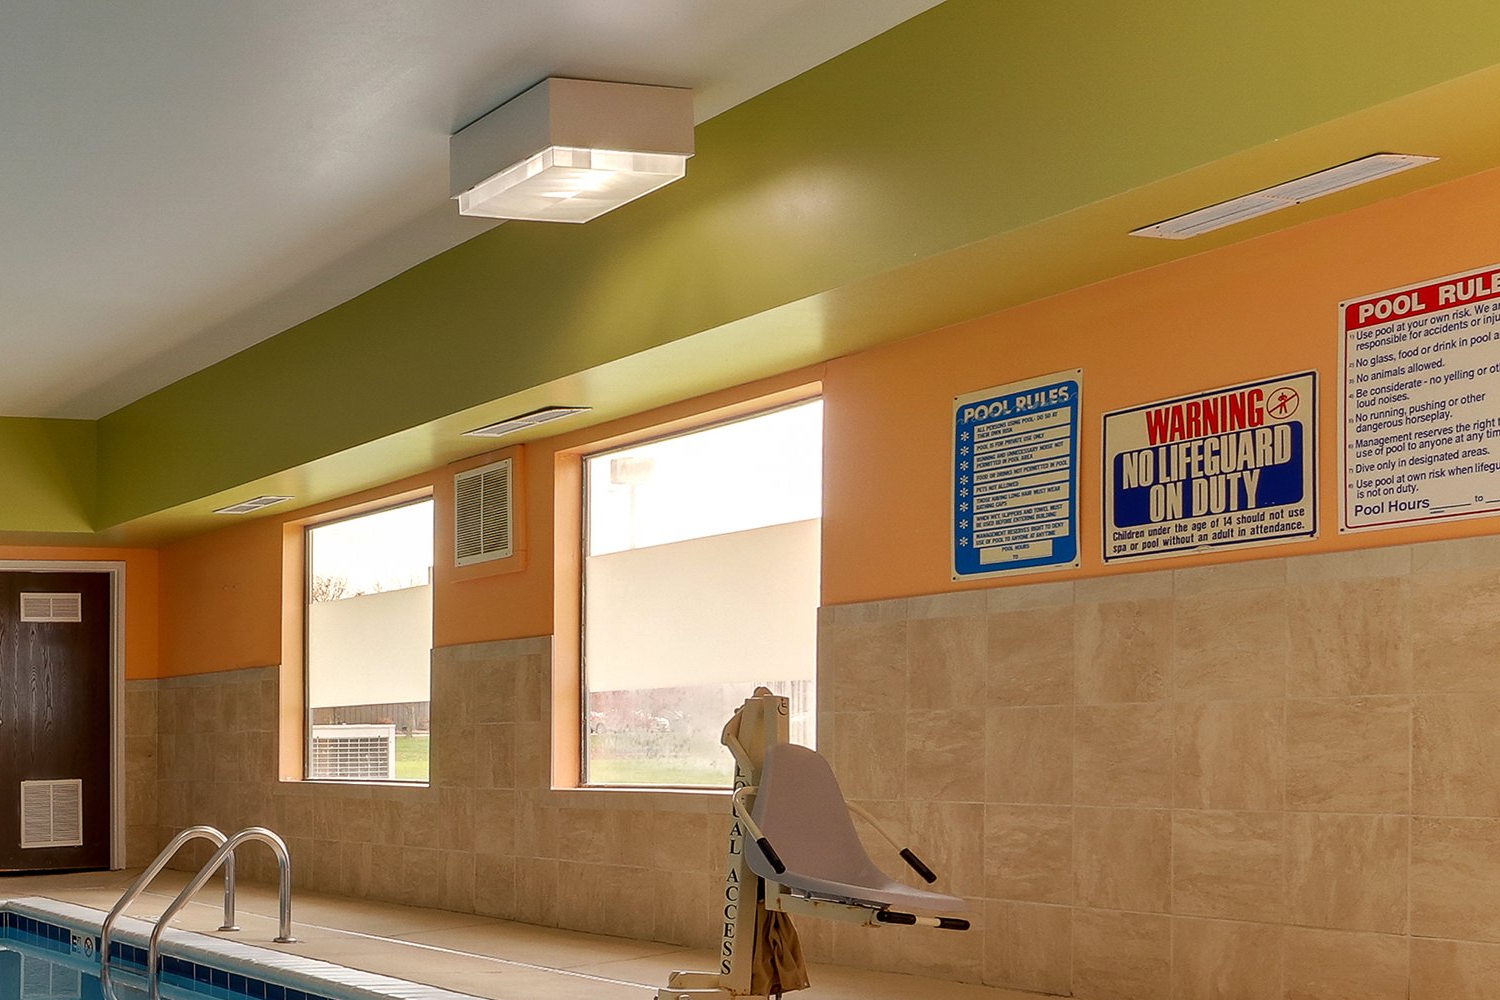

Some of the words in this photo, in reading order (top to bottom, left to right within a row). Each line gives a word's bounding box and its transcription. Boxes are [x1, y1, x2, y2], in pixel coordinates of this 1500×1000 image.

[1356, 330, 1372, 340] Use
[1375, 324, 1393, 339] pool
[1396, 322, 1404, 332] at
[1407, 318, 1427, 331] your
[1430, 314, 1449, 324] own
[1452, 308, 1471, 320] risk.
[1474, 304, 1489, 315] We
[1358, 292, 1426, 324] POOL
[1356, 333, 1406, 351] responsible
[1409, 329, 1420, 339] for
[1423, 320, 1468, 337] accidents
[1470, 318, 1480, 326] or
[1356, 358, 1368, 367] No
[1370, 354, 1396, 366] glass,
[1398, 346, 1418, 359] food
[1421, 346, 1430, 354] or
[1433, 339, 1456, 352] drink
[1459, 337, 1467, 347] in
[1470, 331, 1490, 347] pool
[1356, 373, 1368, 383] No
[1371, 366, 1405, 381] animals
[1407, 358, 1444, 373] allowed.
[1356, 389, 1367, 398] Be
[1370, 379, 1421, 396] considerate
[1429, 376, 1441, 384] no
[1444, 370, 1474, 384] yelling
[1477, 367, 1487, 375] or
[964, 399, 1012, 424] POOL
[1015, 386, 1068, 412] RULES
[1355, 413, 1367, 423] No
[1409, 400, 1445, 415] pushing
[1448, 398, 1457, 406] or
[1460, 393, 1485, 404] other
[1357, 396, 1375, 408] loud
[1378, 393, 1409, 405] noises.
[1146, 389, 1263, 446] WARNING
[1355, 432, 1411, 448] Management
[1414, 426, 1453, 439] reserves
[1455, 423, 1470, 432] the
[1473, 418, 1494, 431] right
[1356, 417, 1402, 433] dangerous
[1405, 409, 1452, 425] horseplay.
[1123, 450, 1153, 489] NO
[1159, 424, 1291, 482] LIFEGUARD
[1356, 449, 1372, 458] use
[1374, 446, 1382, 455] of
[1386, 442, 1405, 455] pool
[1408, 442, 1416, 450] to
[1419, 437, 1452, 449] anyone
[1455, 434, 1463, 443] at
[1466, 432, 1483, 442] any
[1356, 463, 1374, 473] Dive
[1377, 459, 1395, 471] only
[1398, 458, 1406, 467] in
[1408, 449, 1459, 466] designated
[1461, 447, 1490, 458] areas.
[1356, 479, 1372, 488] Use
[1375, 475, 1393, 488] pool
[1396, 474, 1404, 483] at
[1407, 472, 1426, 481] own
[1429, 468, 1445, 479] risk
[1448, 466, 1472, 476] when
[1357, 490, 1364, 498] is
[1367, 488, 1380, 497] not
[1383, 487, 1394, 495] on
[1396, 484, 1418, 494] duty.
[1150, 483, 1182, 522] ON
[1192, 469, 1260, 516] DUTY
[1354, 502, 1383, 516] Pool
[1388, 499, 1429, 512] Hours
[1113, 530, 1143, 541] Children
[1148, 526, 1170, 536] under
[1175, 523, 1187, 532] the
[1192, 522, 1206, 532] age
[1210, 518, 1218, 528] of
[1223, 516, 1231, 525] 14
[1237, 512, 1264, 524] should
[1269, 510, 1283, 520] not
[1288, 508, 1304, 517] use
[1113, 544, 1126, 553] spa
[1142, 538, 1158, 550] pool
[1162, 534, 1193, 546] without
[1198, 534, 1207, 542] an
[1212, 528, 1233, 540] adult
[1238, 527, 1245, 537] in
[1251, 521, 1304, 535] attendance.
[720, 868, 739, 975] ACCESS
